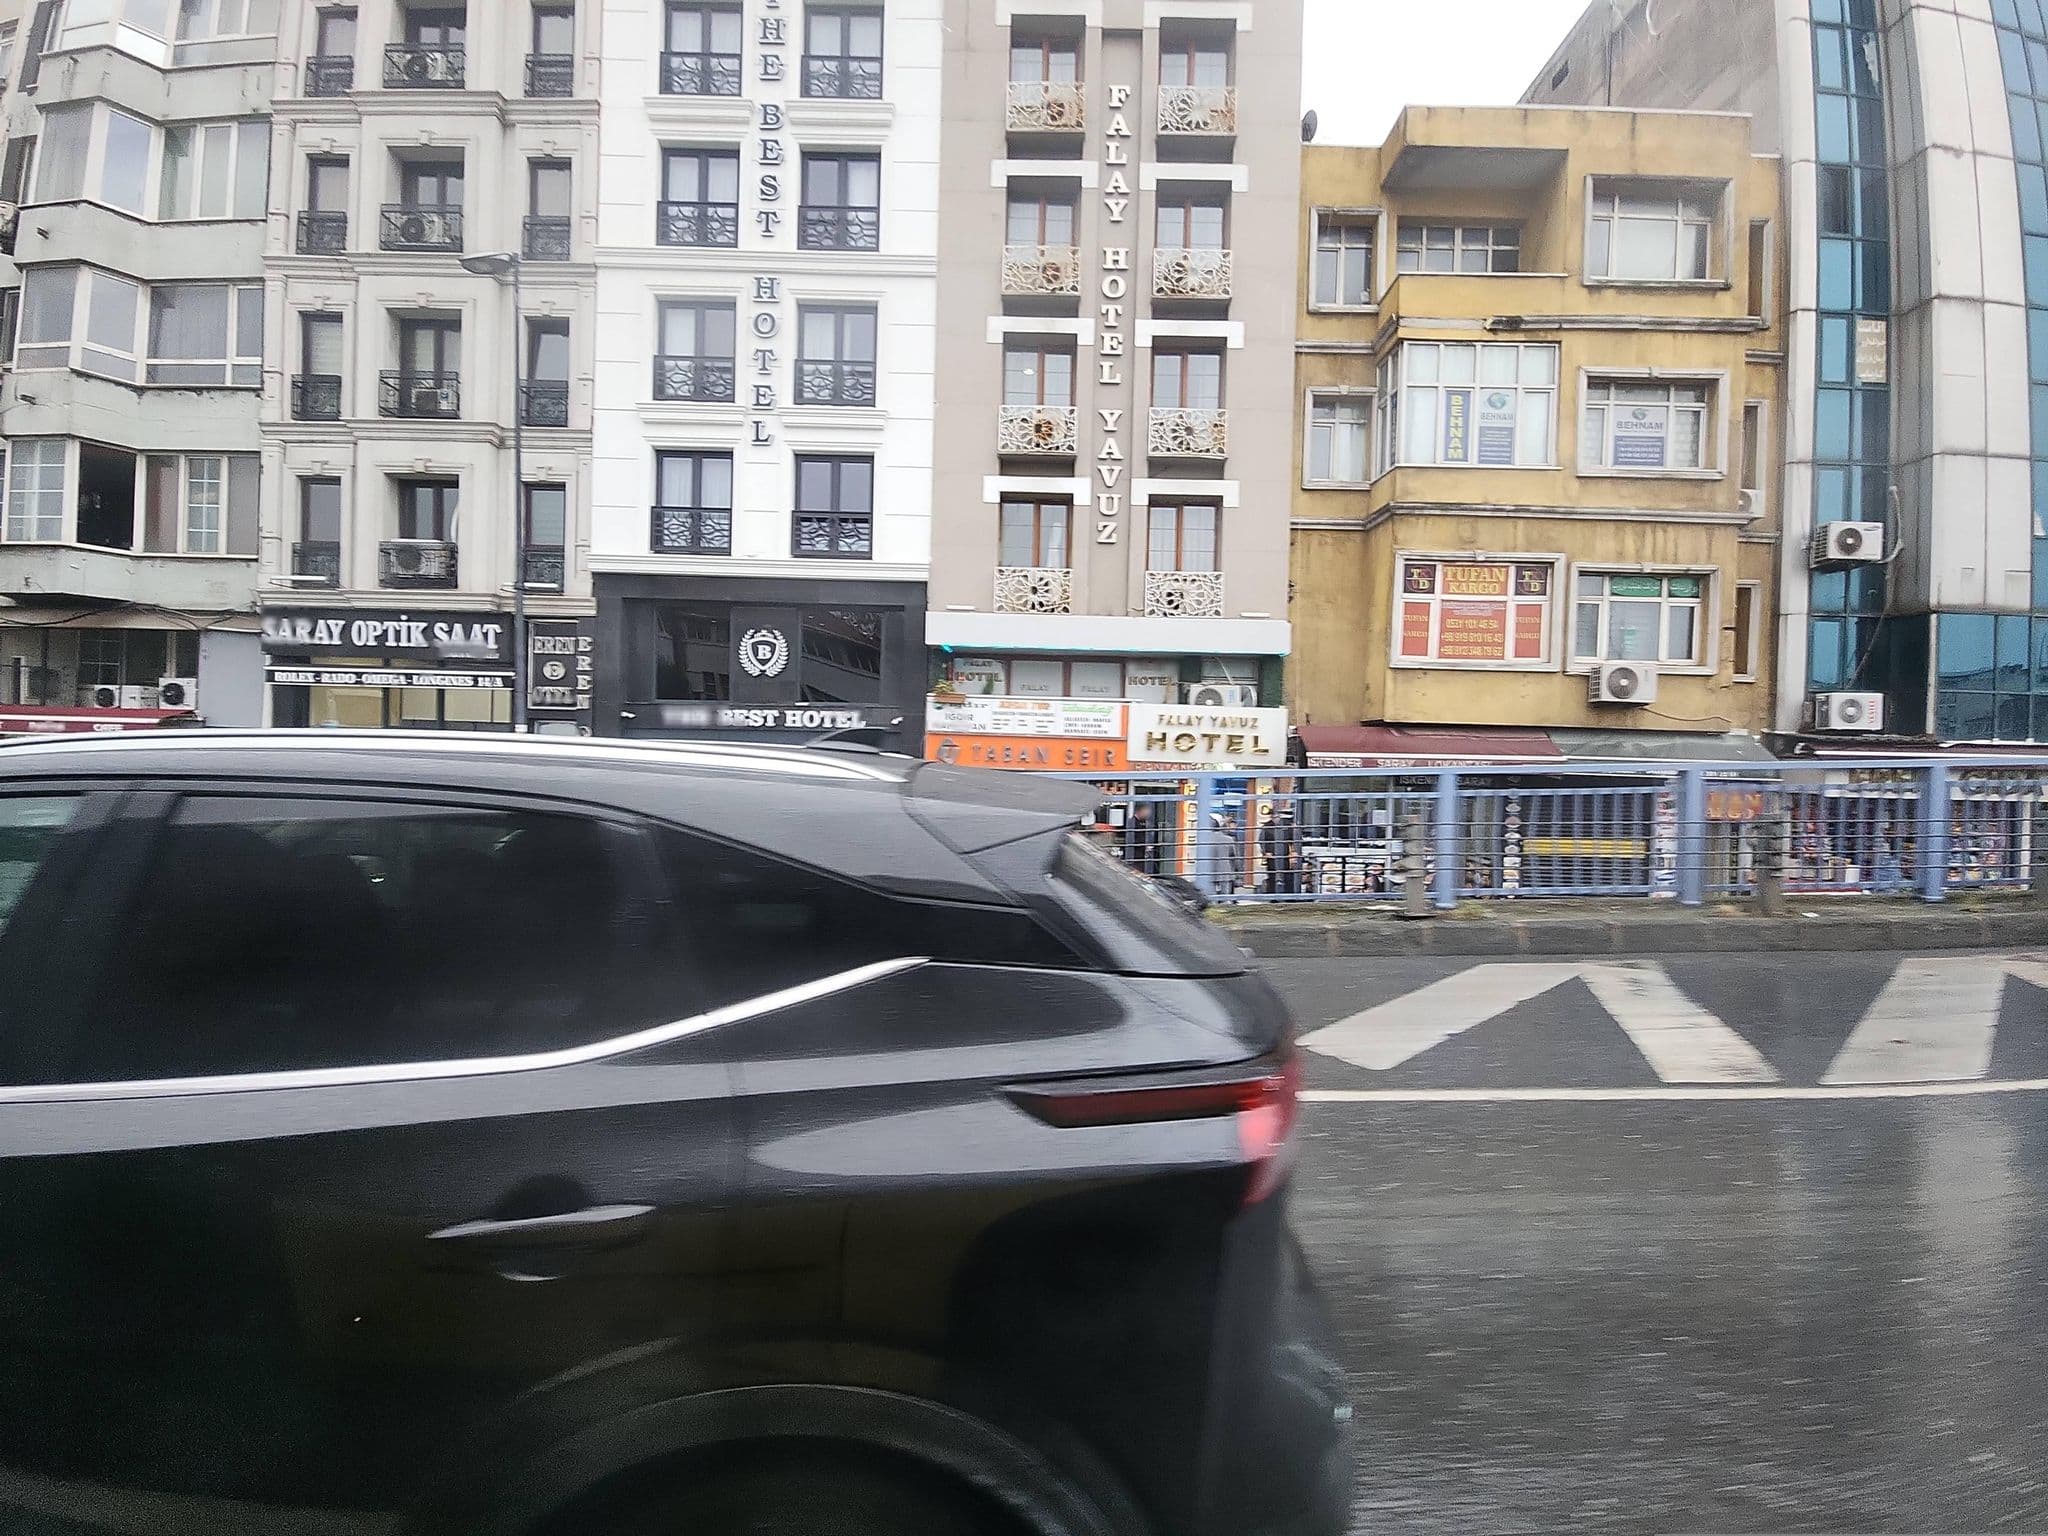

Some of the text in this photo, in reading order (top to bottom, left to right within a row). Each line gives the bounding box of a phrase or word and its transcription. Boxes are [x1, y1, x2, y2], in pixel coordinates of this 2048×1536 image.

[751, 0, 786, 446] HE BEST HOTEL
[1096, 84, 1132, 544] FALAY HOTEL YAVUZ
[1447, 394, 1465, 460] BEHNAM
[1615, 420, 1664, 431] BEHNAM
[1444, 566, 1507, 582] TUFAN
[1448, 582, 1500, 594] KARGO
[351, 614, 429, 647] OPTİK
[433, 622, 503, 650] SAAT
[533, 636, 576, 654] EREN
[1127, 675, 1178, 687] HOTEL
[716, 709, 780, 728] BEST
[784, 709, 867, 728] HOTEL
[1157, 713, 1260, 729] FALAY YAVUZ
[1145, 731, 1270, 754] HOTEL
